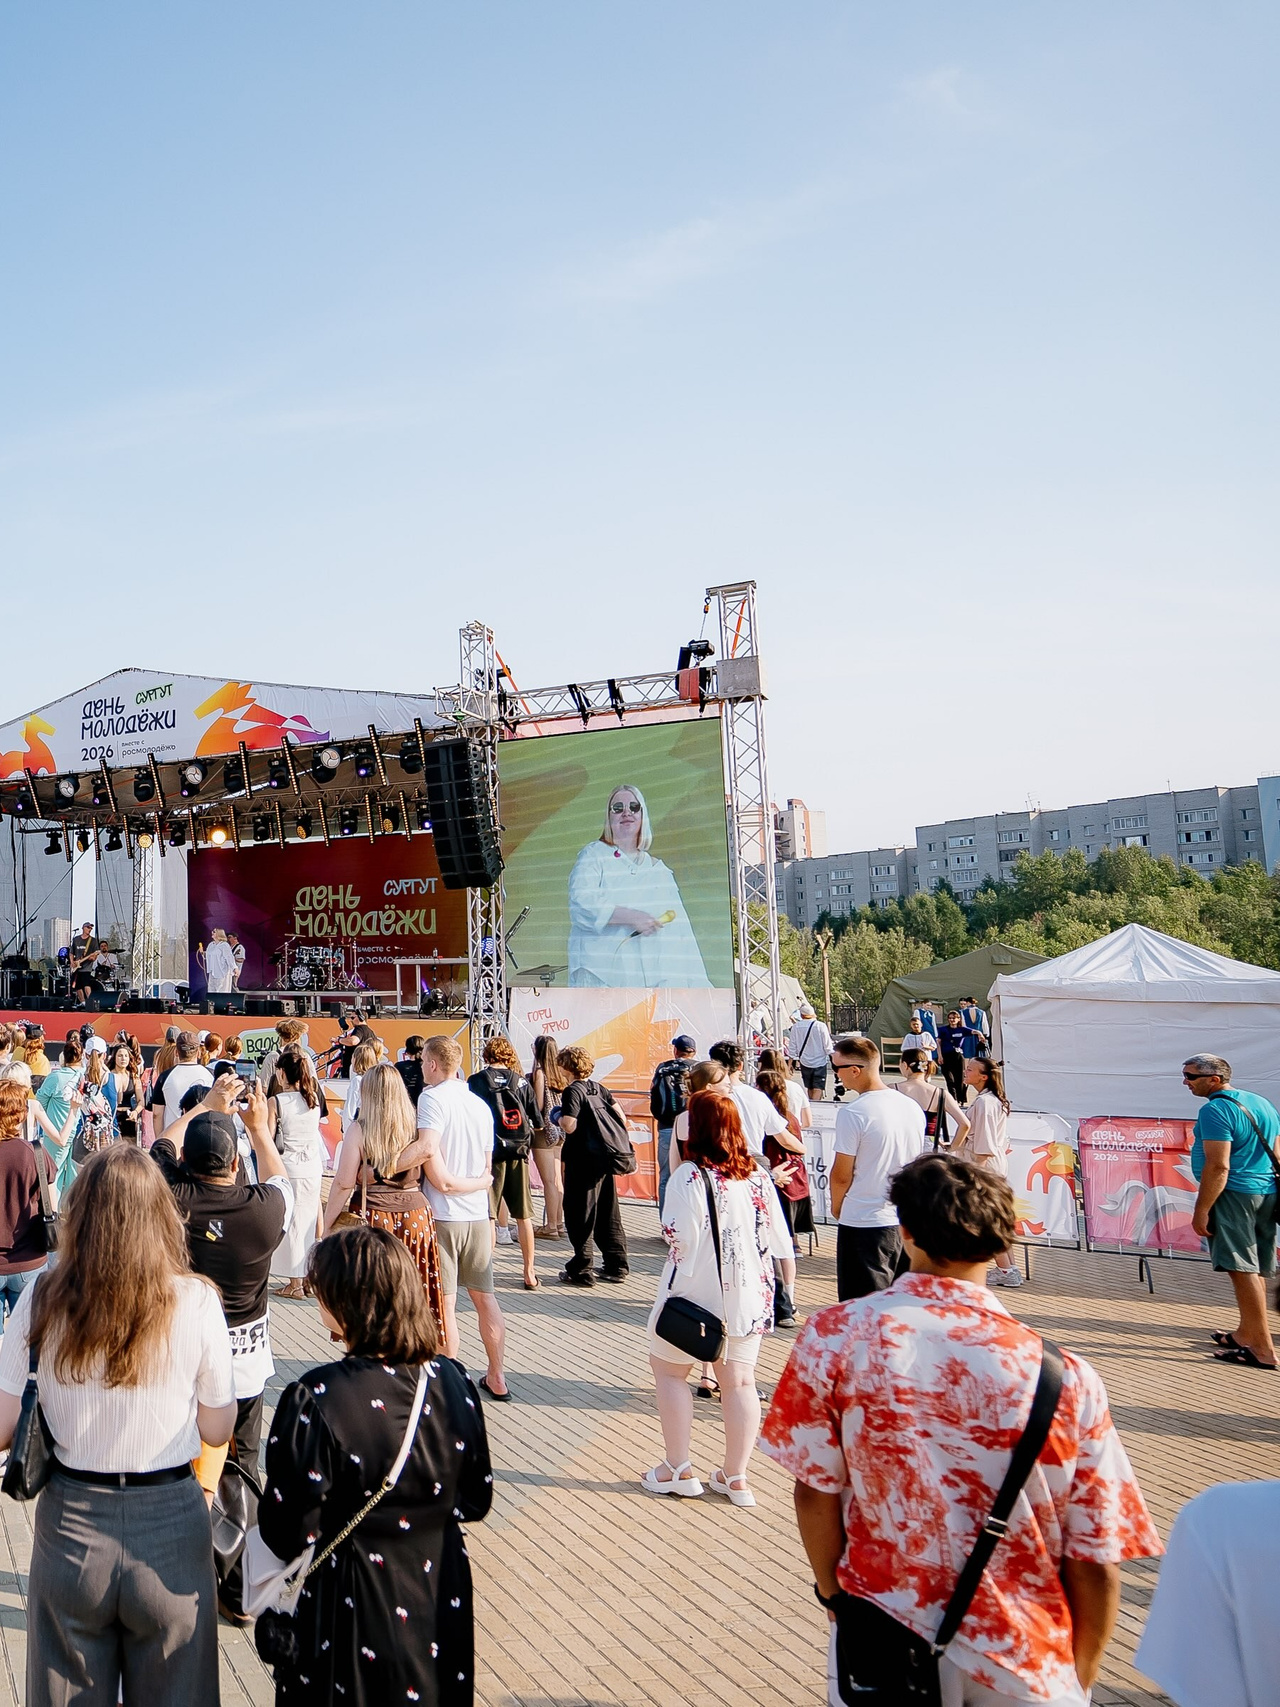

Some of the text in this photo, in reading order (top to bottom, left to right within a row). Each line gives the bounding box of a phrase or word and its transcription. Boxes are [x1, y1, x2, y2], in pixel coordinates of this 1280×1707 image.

[81, 708, 176, 740] МОЛОДЁЖИ
[81, 745, 114, 761] 2026
[383, 877, 438, 896] СУРГУТ
[527, 1008, 552, 1023] ГОРИ
[541, 1018, 570, 1034] ЯРКО
[1093, 1153, 1119, 1161] 2026
